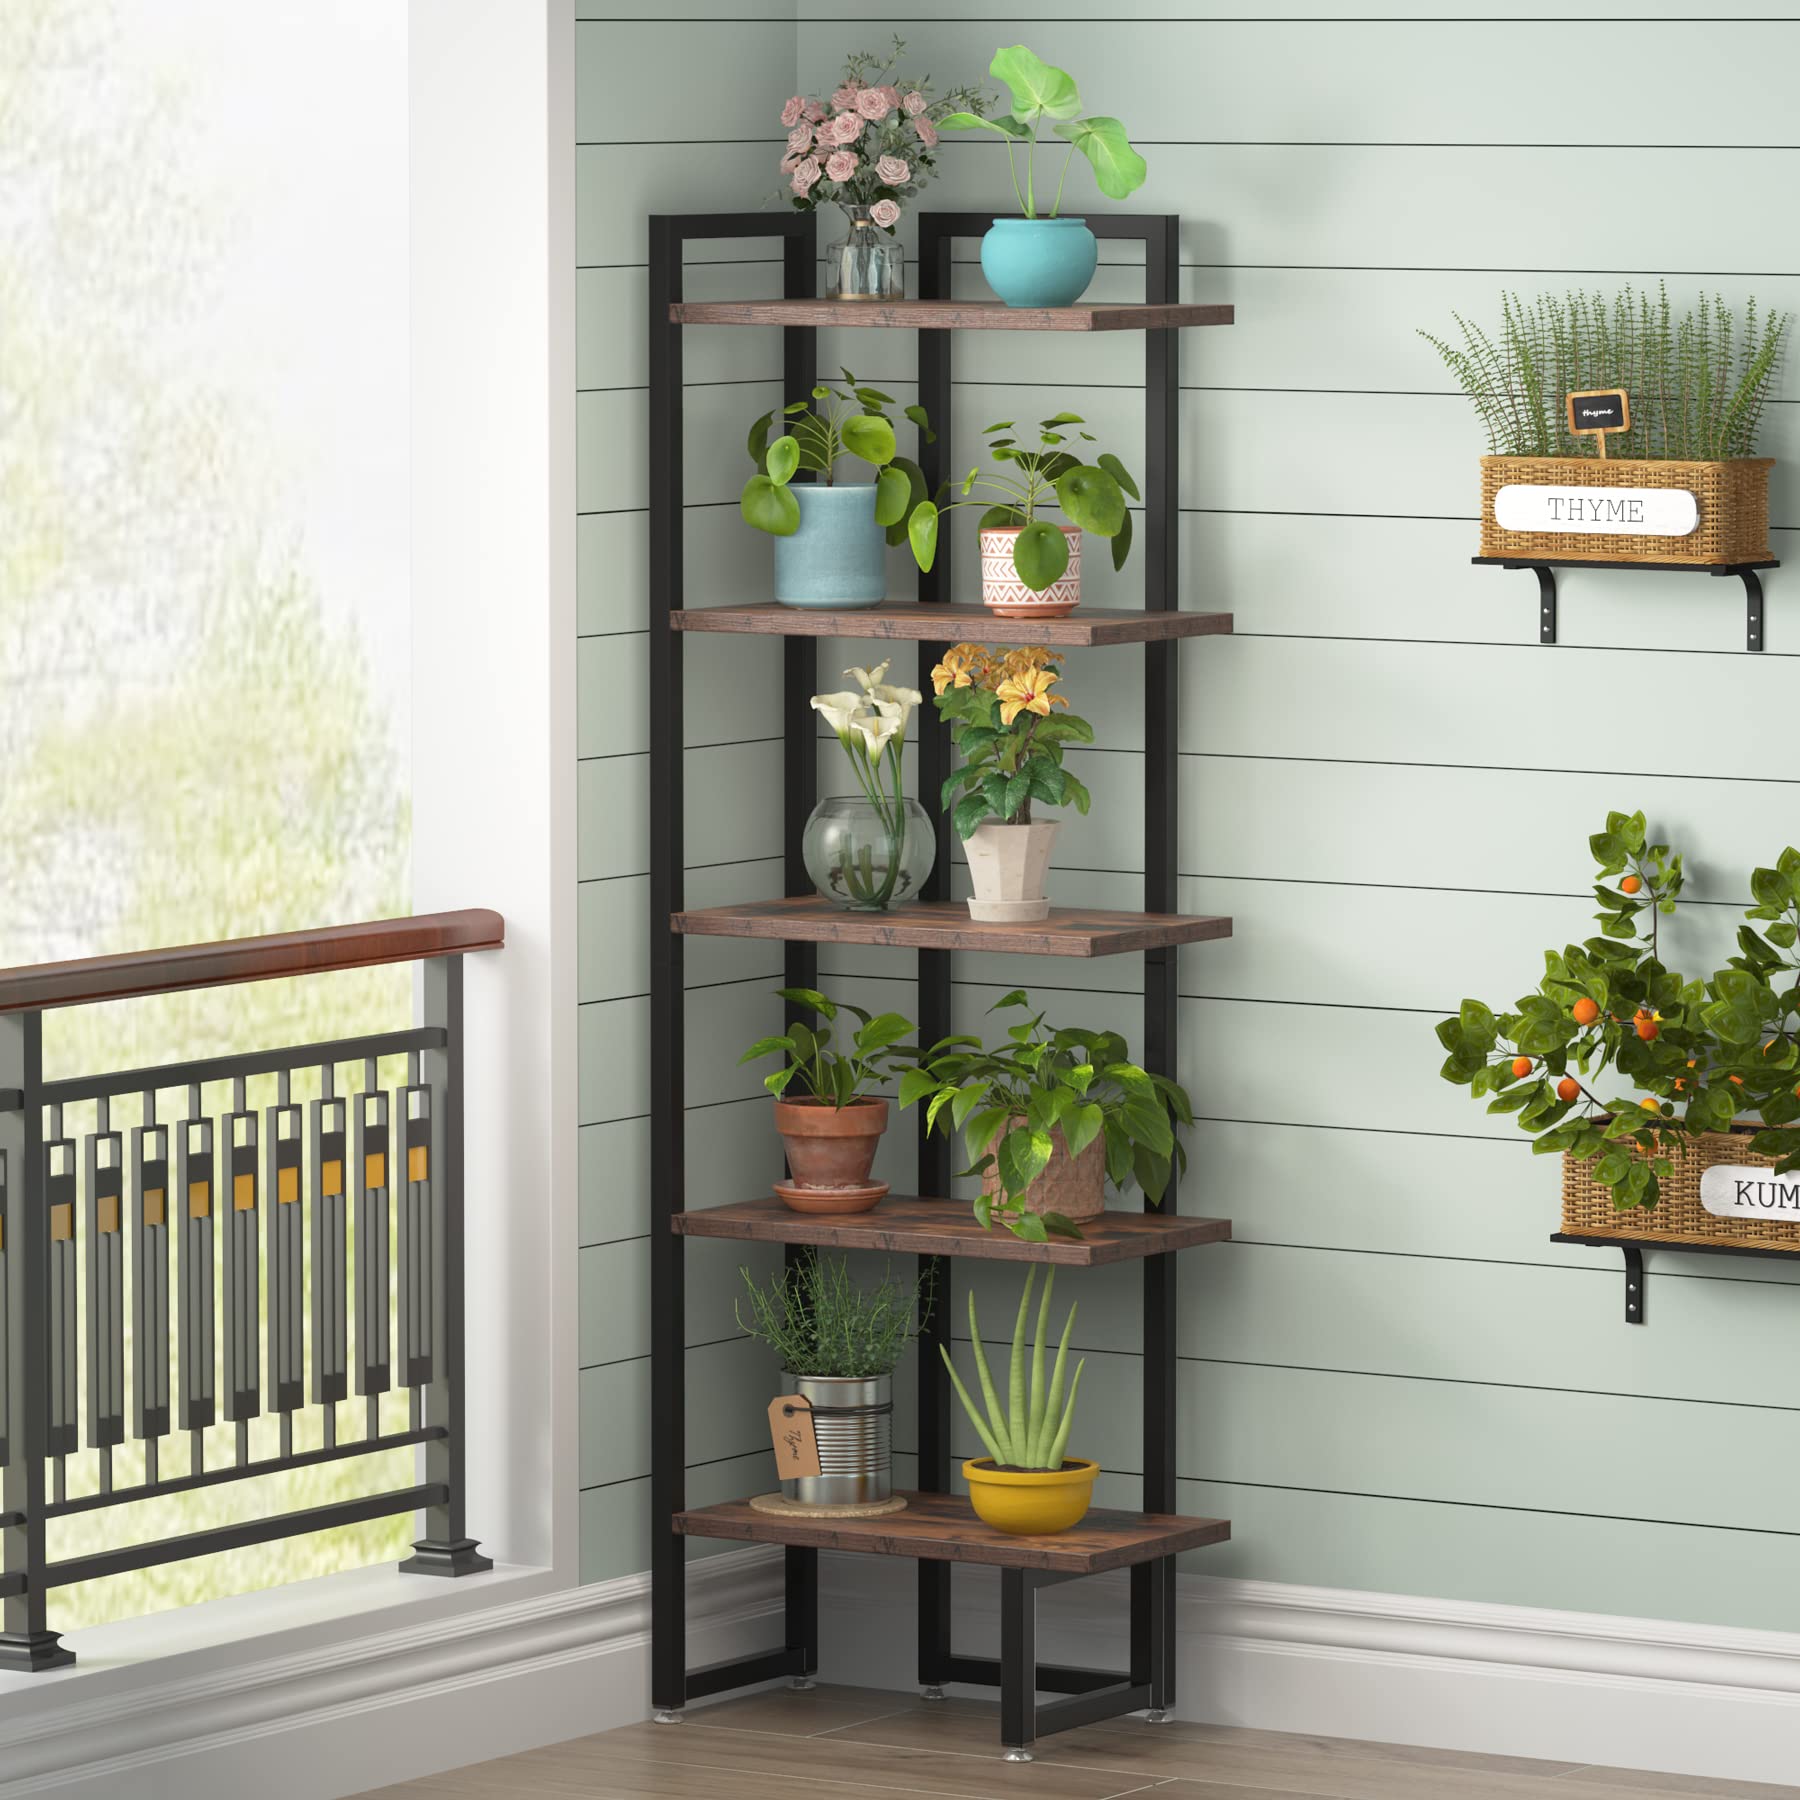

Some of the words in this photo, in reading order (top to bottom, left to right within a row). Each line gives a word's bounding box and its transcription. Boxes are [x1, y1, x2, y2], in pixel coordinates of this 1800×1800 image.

[1582, 408, 1614, 418] thyme
[1547, 497, 1644, 523] THYME
[1734, 1180, 1800, 1210] KUM
